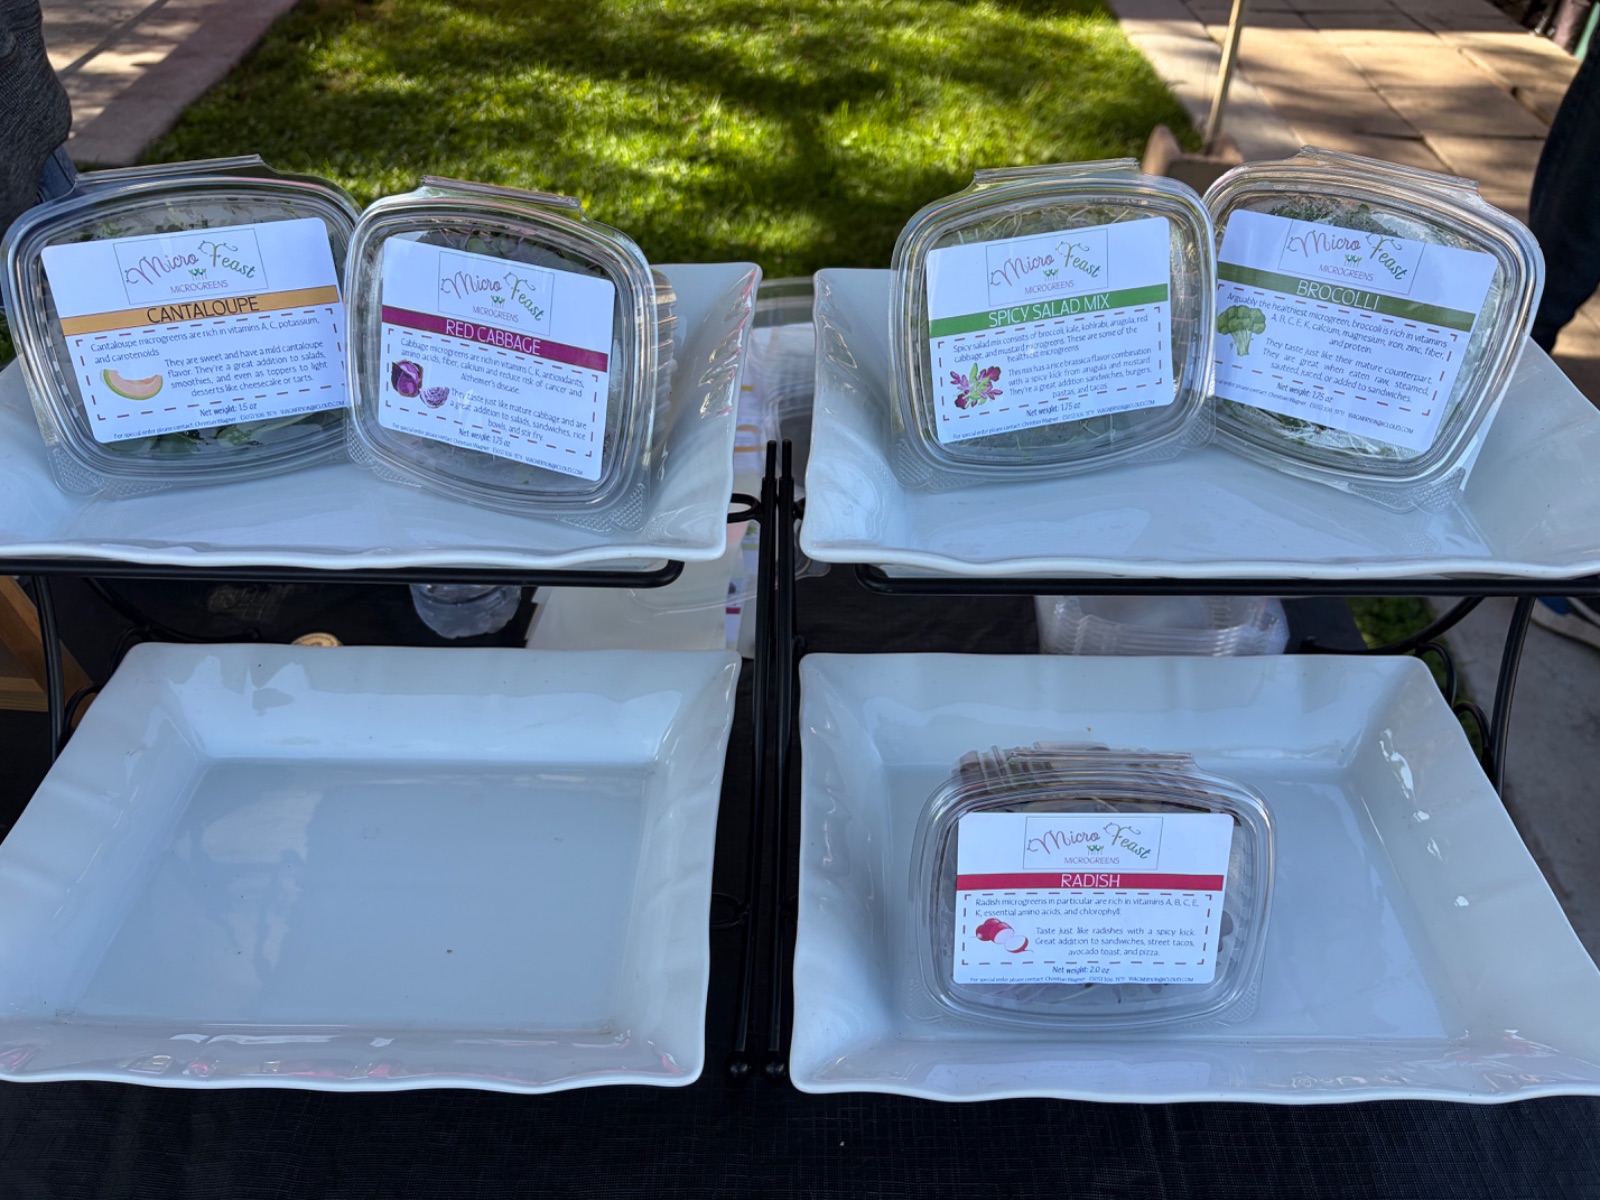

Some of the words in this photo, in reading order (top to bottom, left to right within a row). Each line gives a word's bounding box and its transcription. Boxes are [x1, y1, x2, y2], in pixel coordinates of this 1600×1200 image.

[125, 253, 199, 285] Micro
[198, 240, 257, 279] Feast
[1286, 230, 1361, 258] Micro
[1366, 233, 1408, 280] Feast
[990, 254, 1055, 287] Micro
[1055, 241, 1101, 278] Feast
[1318, 264, 1374, 281] MICROGREENS
[170, 280, 228, 294] MICROGREENS
[440, 270, 502, 299] Micro
[503, 271, 544, 321] Feast
[1025, 280, 1074, 294] MICROGREENS
[1296, 280, 1380, 311] BROCOLLI
[147, 296, 260, 325] CANTALOUPE
[473, 306, 519, 322] MICROGREENS
[989, 305, 1030, 328] SPICY
[1032, 298, 1081, 319] SALAD
[1084, 293, 1110, 311] MIX
[1226, 292, 1258, 307] Arguably
[1258, 299, 1271, 309] the
[1271, 301, 1308, 317] healthiest
[1308, 311, 1351, 328] microgreen,
[1389, 327, 1406, 339] rich
[1414, 334, 1448, 348] vitamins
[90, 339, 138, 352] Cantaloupe
[138, 333, 188, 346] microgreens
[188, 331, 202, 339] are
[202, 327, 218, 337] rich
[226, 323, 260, 334] vitamins
[277, 317, 320, 330] potassium,
[445, 319, 474, 340] RED
[477, 326, 541, 355] CABBAGE
[94, 353, 111, 364] and
[111, 347, 160, 362] carotenoids
[163, 358, 185, 368] They
[185, 356, 199, 365] are
[199, 352, 223, 363] sweet
[224, 350, 240, 360] and
[239, 349, 258, 358] have
[281, 341, 324, 353] cantaloupe
[1265, 337, 1283, 349] They
[1284, 342, 1304, 354] taste
[1303, 348, 1320, 357] just
[1320, 350, 1333, 361] like
[1334, 354, 1353, 365] their
[1354, 360, 1383, 373] mature
[167, 369, 193, 378] flavor.
[193, 364, 224, 374] They're
[232, 359, 254, 371] great
[256, 356, 288, 367] addition
[170, 377, 214, 389] smoothies,
[215, 372, 232, 383] and
[233, 372, 252, 380] even
[266, 365, 297, 376] toppers
[310, 360, 328, 371] light
[190, 386, 225, 397] desserts
[224, 383, 238, 392] like
[239, 377, 282, 391] cheesecake
[1275, 381, 1289, 392] Net
[199, 408, 212, 417] Net
[1025, 408, 1037, 417] Net
[458, 427, 470, 437] Net
[1027, 826, 1101, 855] Micro
[1103, 822, 1152, 859] Feast
[1064, 857, 1120, 865] MICROGREENS
[1060, 874, 1121, 888] RADISH
[975, 897, 1001, 906] Radish
[1001, 898, 1047, 907] microgreens
[1055, 897, 1093, 906] particular
[1107, 897, 1123, 905] rich
[1132, 898, 1165, 906] vitamins
[983, 908, 1017, 917] essential
[1041, 907, 1062, 916] acids,
[1063, 907, 1079, 915] and
[1035, 926, 1056, 935] Taste
[1058, 927, 1073, 935] just
[1076, 926, 1089, 935] like
[1091, 926, 1123, 935] radishes
[1126, 927, 1144, 935] with
[1156, 928, 1176, 937] spicy
[1034, 937, 1056, 945] Great
[1057, 937, 1089, 945] addition
[1100, 937, 1146, 946] sandwiches,
[1147, 938, 1170, 946] street
[1172, 939, 1195, 947] tacos,
[1067, 947, 1099, 956] avocado
[1100, 948, 1122, 956] toast,
[1123, 947, 1138, 955] and
[1051, 966, 1065, 974] Net
